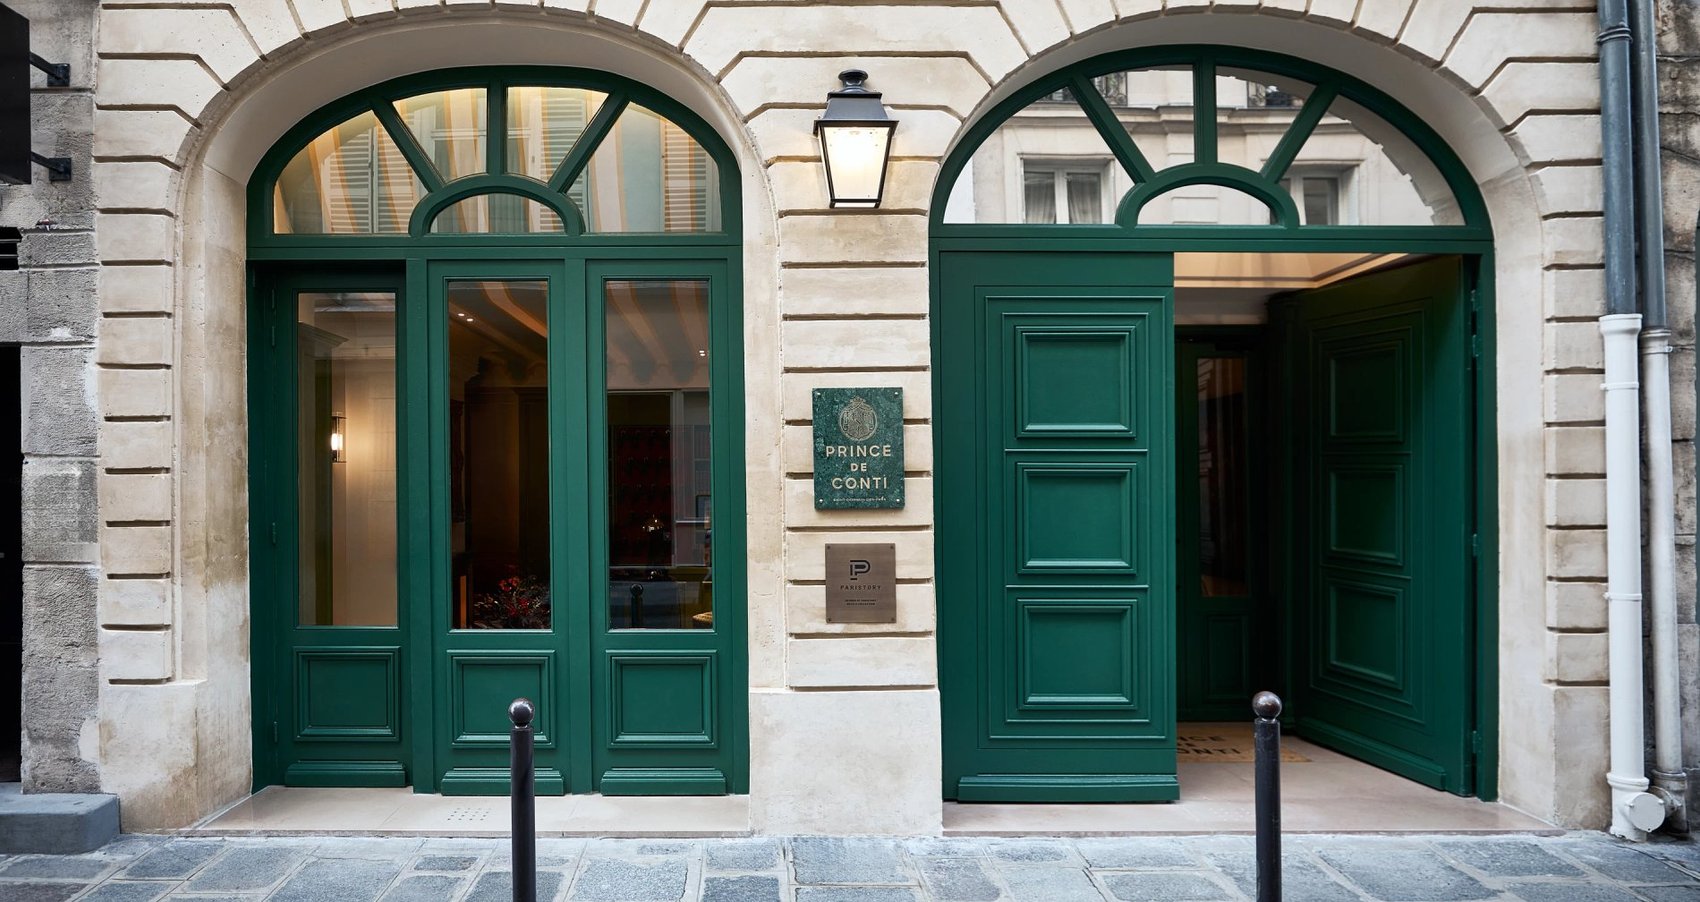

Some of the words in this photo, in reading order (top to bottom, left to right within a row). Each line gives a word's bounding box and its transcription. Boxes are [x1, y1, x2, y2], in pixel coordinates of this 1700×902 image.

[825, 445, 892, 458] PRINCE
[850, 463, 867, 472] DE
[831, 477, 887, 490] CONTI
